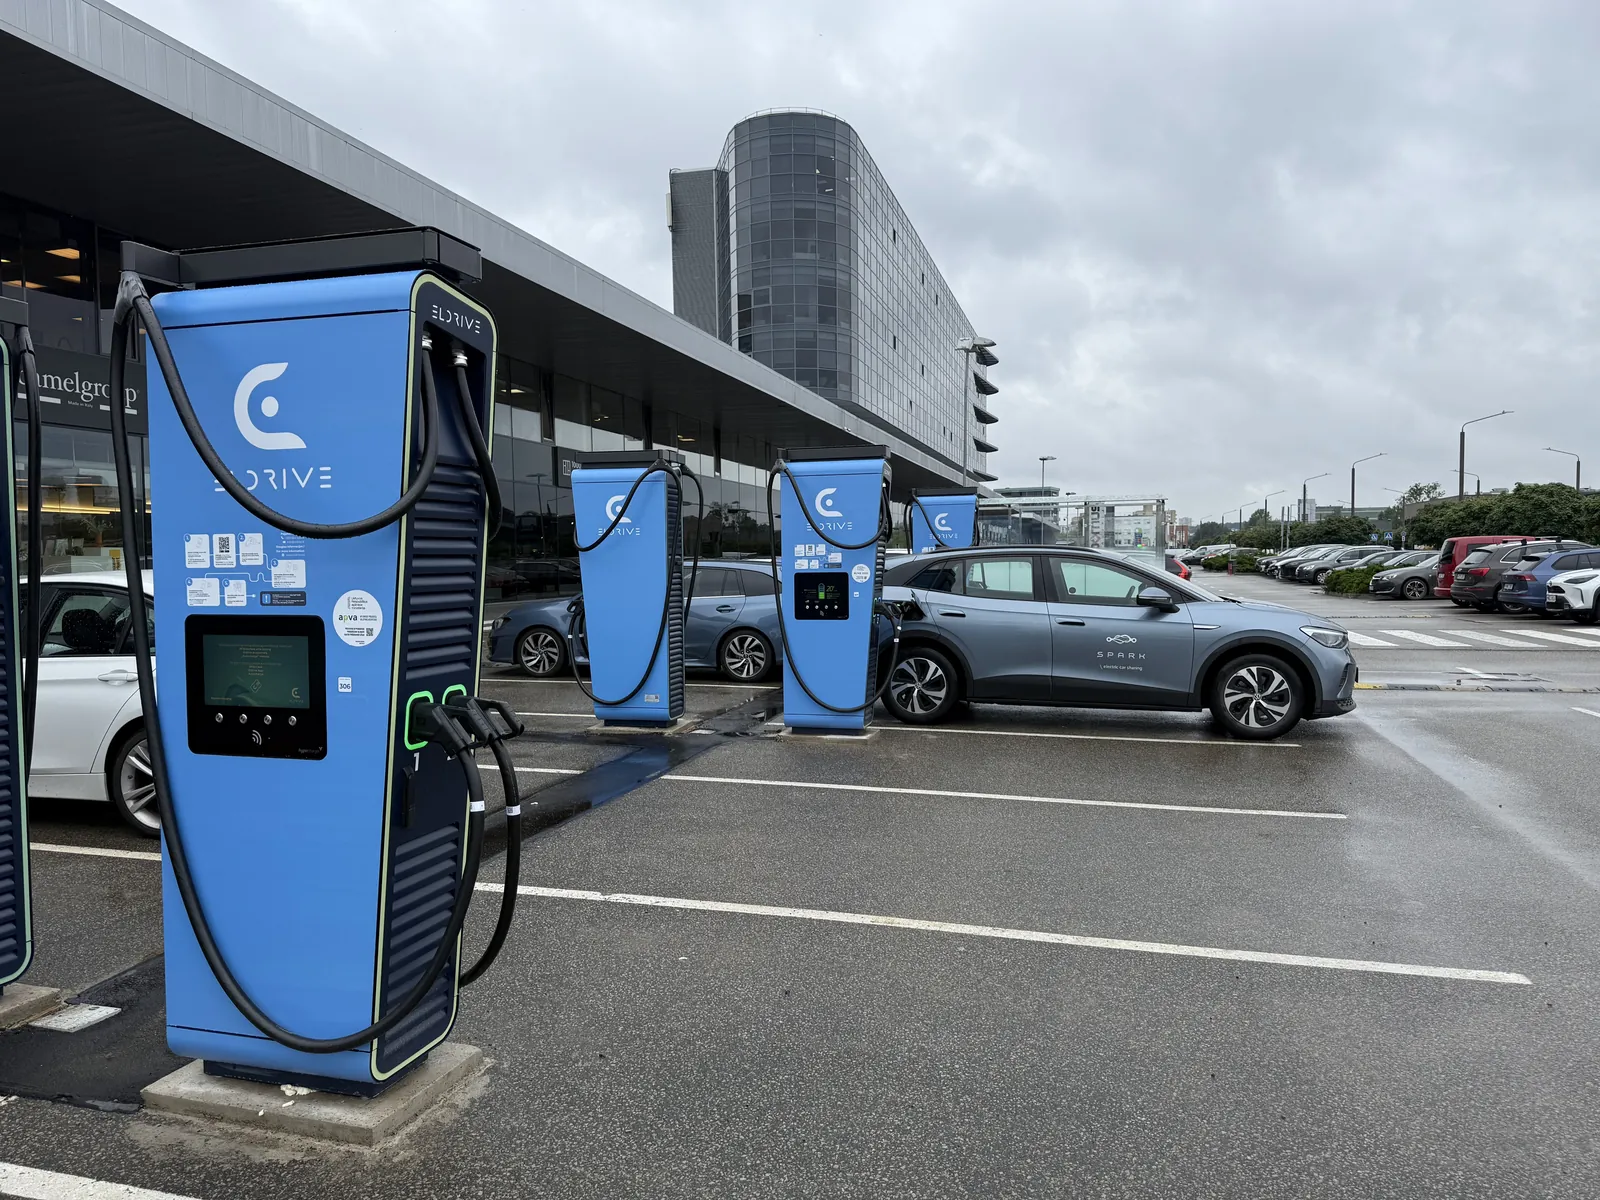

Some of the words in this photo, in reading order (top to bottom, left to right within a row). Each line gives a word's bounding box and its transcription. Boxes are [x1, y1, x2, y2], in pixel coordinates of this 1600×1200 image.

[432, 304, 481, 334] ELDRIVE
[18, 369, 137, 409] cmelgrop
[214, 466, 332, 492] DRIVE
[807, 521, 853, 532] EDRIVE
[338, 614, 358, 623] apva
[1096, 651, 1146, 660] SPARK
[339, 682, 351, 690] 306
[413, 751, 420, 772] 1
